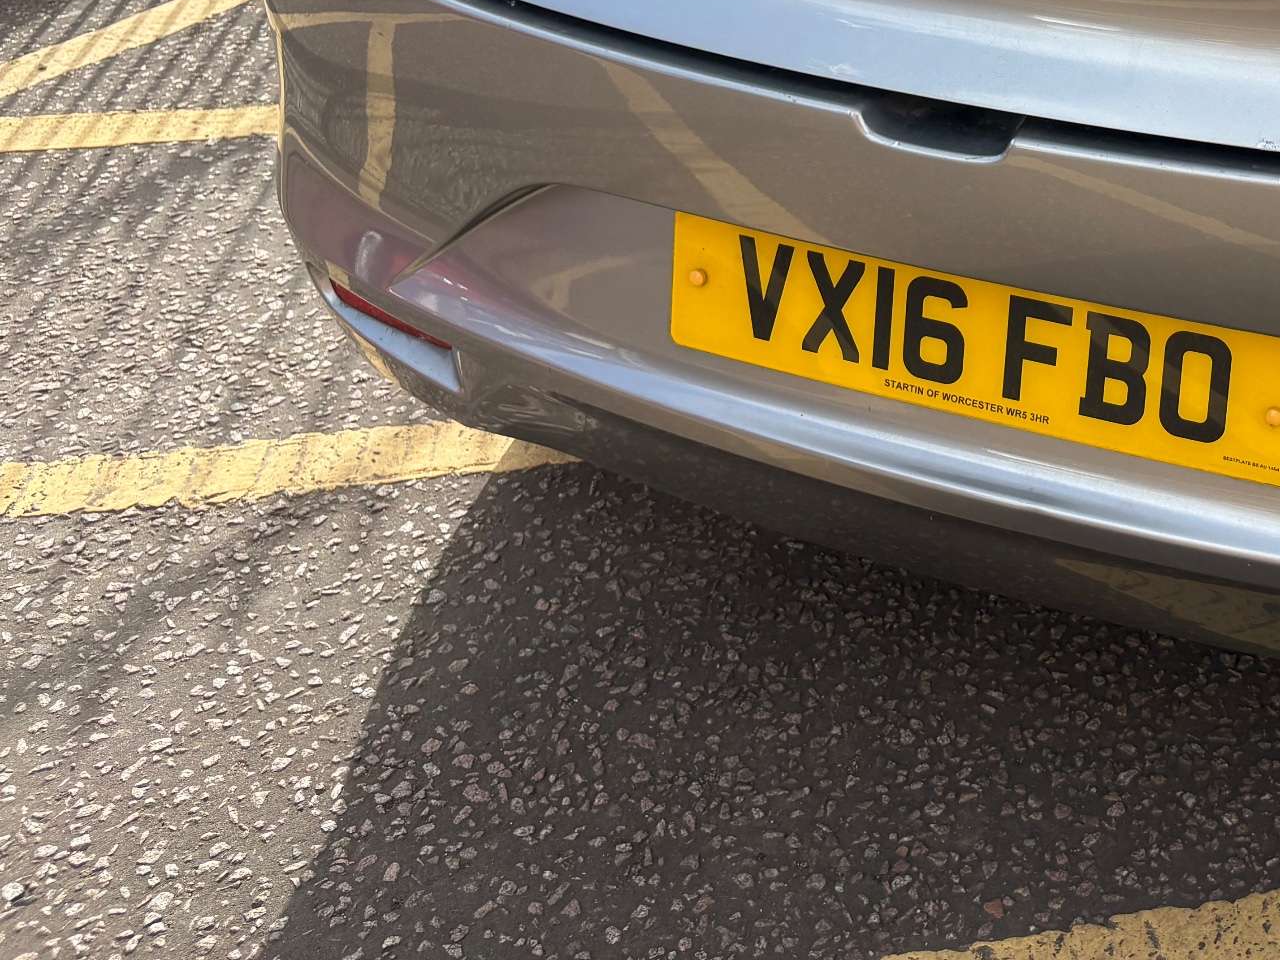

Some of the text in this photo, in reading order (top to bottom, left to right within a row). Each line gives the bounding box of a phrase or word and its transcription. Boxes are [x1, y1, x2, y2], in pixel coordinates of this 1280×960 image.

[739, 234, 1232, 443] VX16 FBO
[884, 378, 1050, 424] STARTIN OF WORCESTER WR5 3HR
